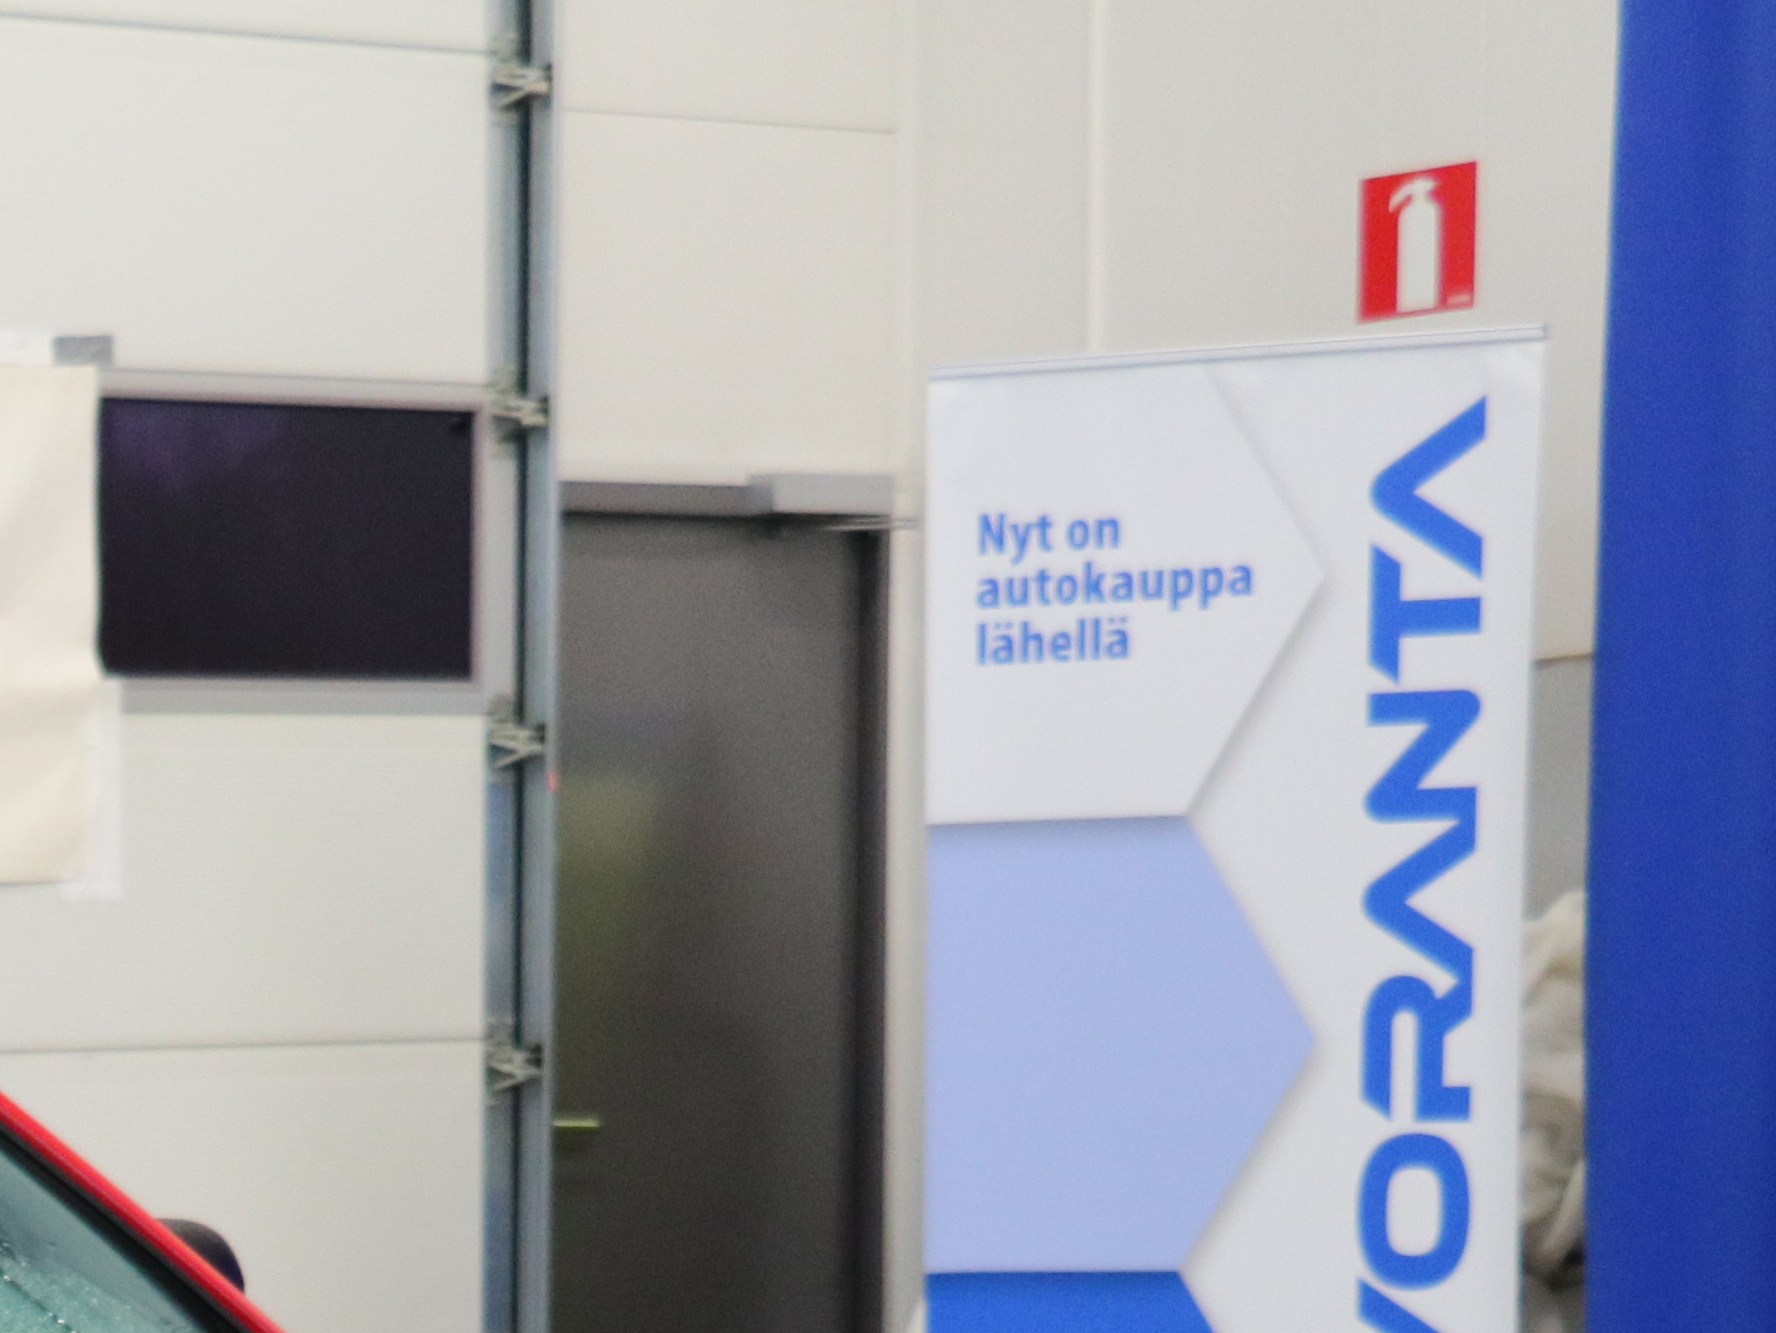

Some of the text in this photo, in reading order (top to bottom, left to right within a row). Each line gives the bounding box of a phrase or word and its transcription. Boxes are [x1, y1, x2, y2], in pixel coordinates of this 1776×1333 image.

[977, 512, 1122, 566] Nyt on
[976, 561, 1253, 612] autokauppa
[976, 615, 1130, 666] lähellä
